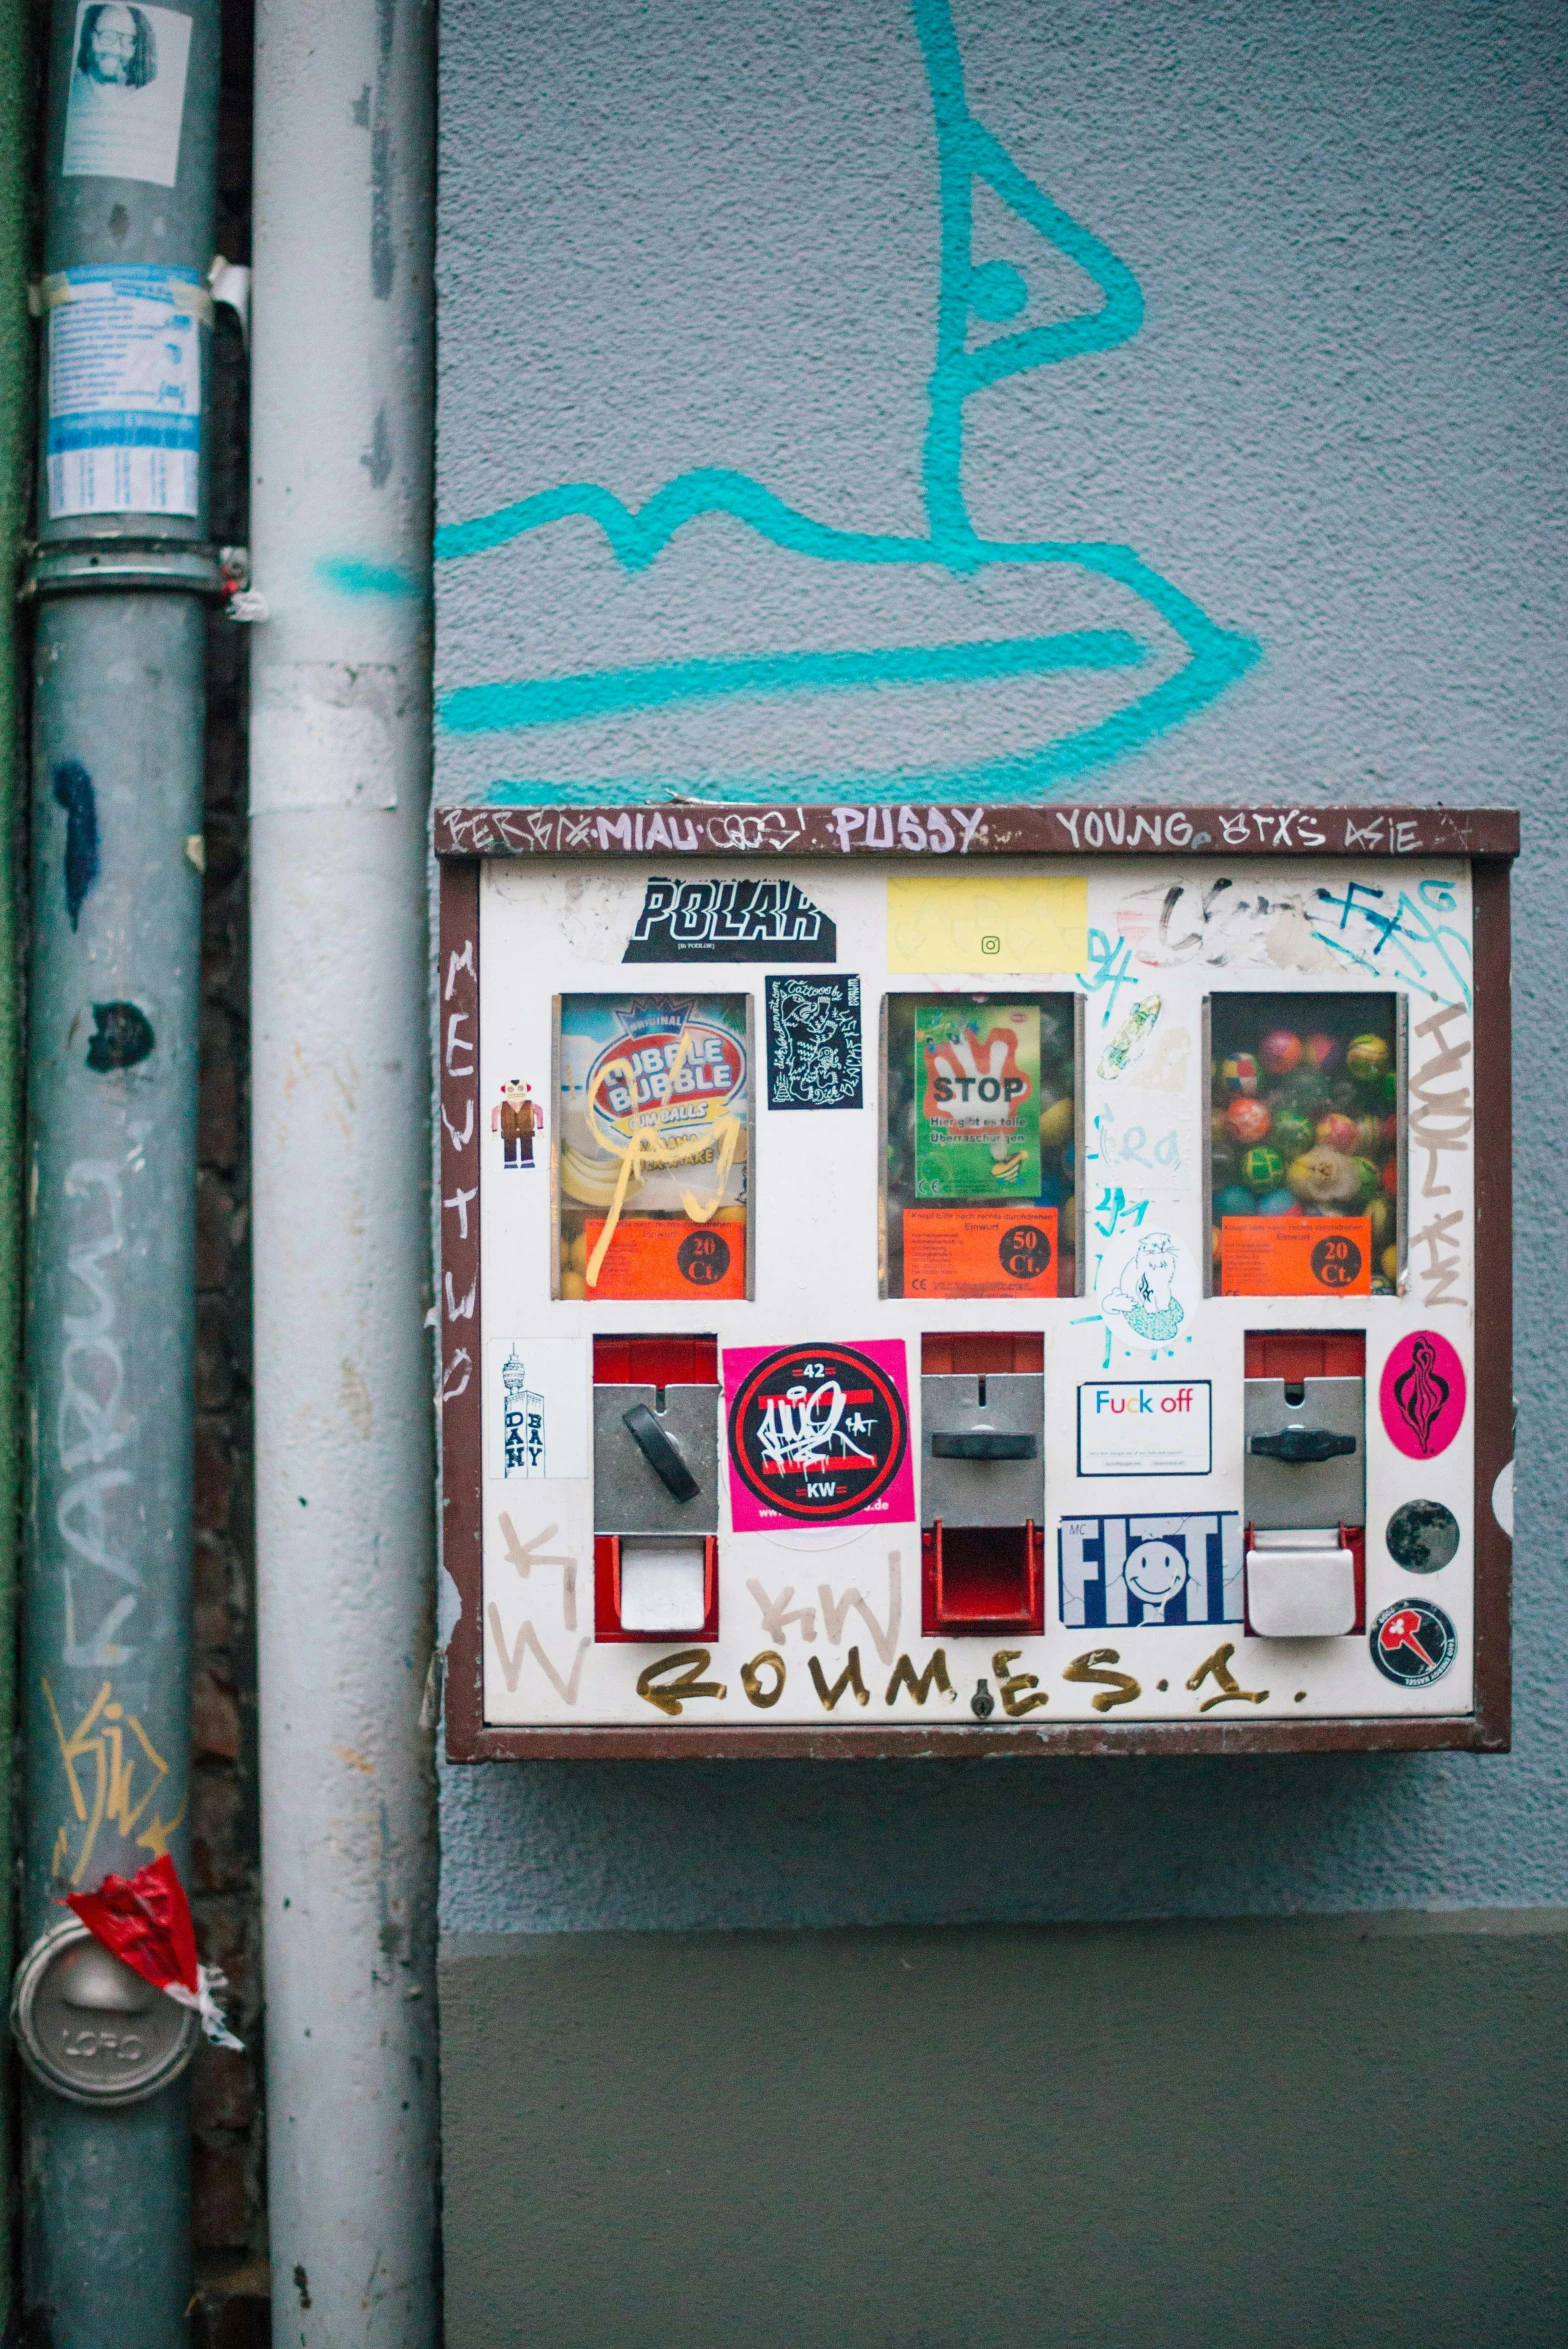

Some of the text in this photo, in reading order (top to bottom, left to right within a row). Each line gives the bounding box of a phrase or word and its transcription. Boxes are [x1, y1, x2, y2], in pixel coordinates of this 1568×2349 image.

[596, 812, 698, 850] MIAU
[832, 805, 984, 854] PUSSY
[1056, 809, 1193, 848] YOUNG
[630, 1015, 682, 1031] ORIGINAL
[933, 1077, 1024, 1103] STOP
[660, 1102, 709, 1123] BALLS
[693, 1237, 716, 1256] 20
[1012, 1231, 1038, 1250] 50
[1324, 1241, 1349, 1260] 20
[688, 1260, 719, 1281] Ct.
[1009, 1254, 1041, 1273] Ct.
[1320, 1264, 1351, 1283] Ct.
[803, 1363, 825, 1379] 42
[1096, 1387, 1194, 1415] Fuck off
[807, 1481, 836, 1498] KW
[1069, 1524, 1087, 1535] MC
